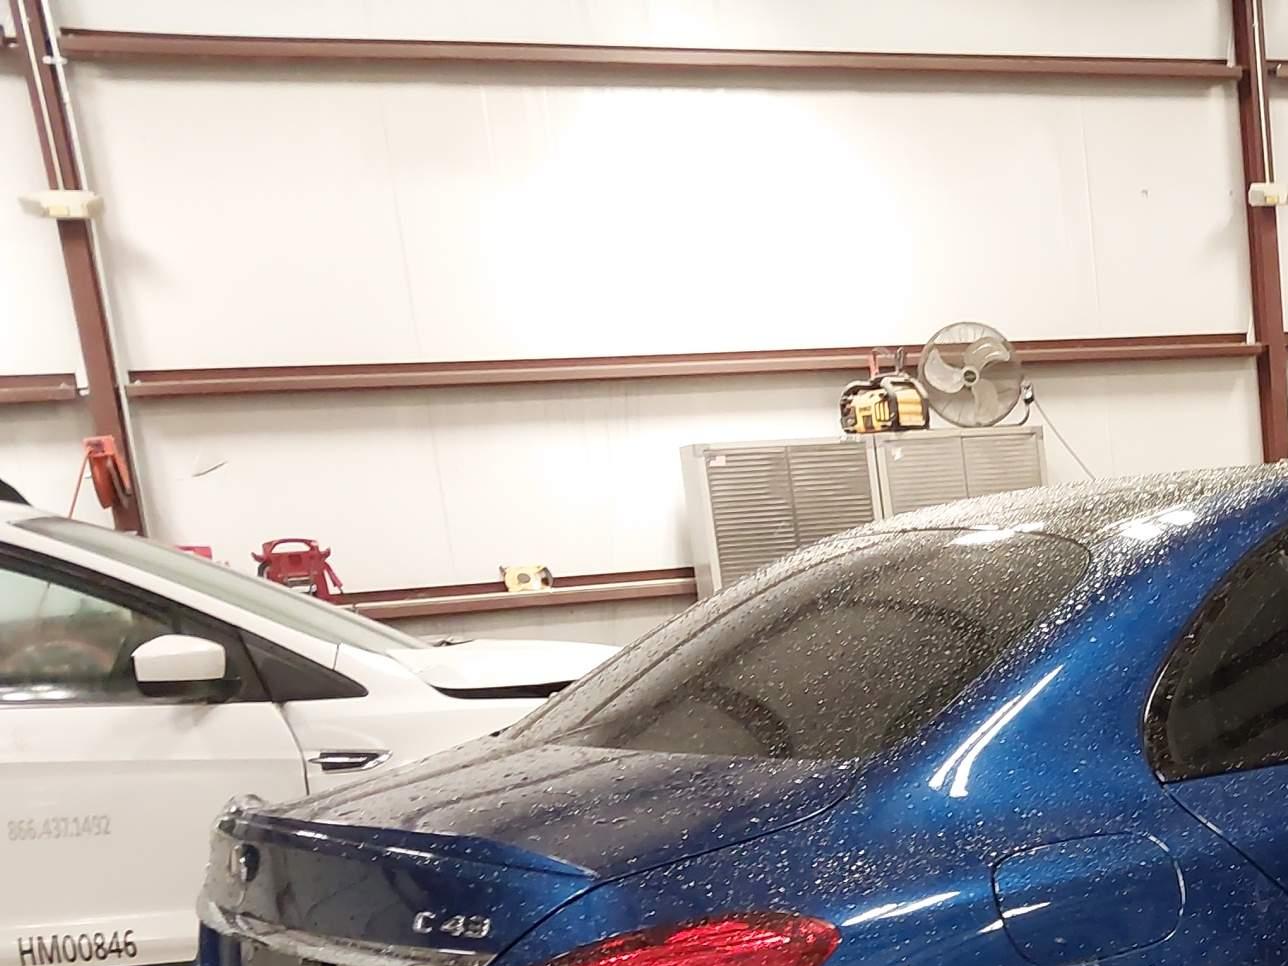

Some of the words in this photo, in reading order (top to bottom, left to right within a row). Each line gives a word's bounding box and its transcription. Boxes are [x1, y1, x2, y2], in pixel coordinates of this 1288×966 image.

[8, 816, 112, 842] 866.437.1492
[412, 911, 437, 934] C
[439, 915, 492, 939] 43
[17, 929, 138, 966] HM00846
